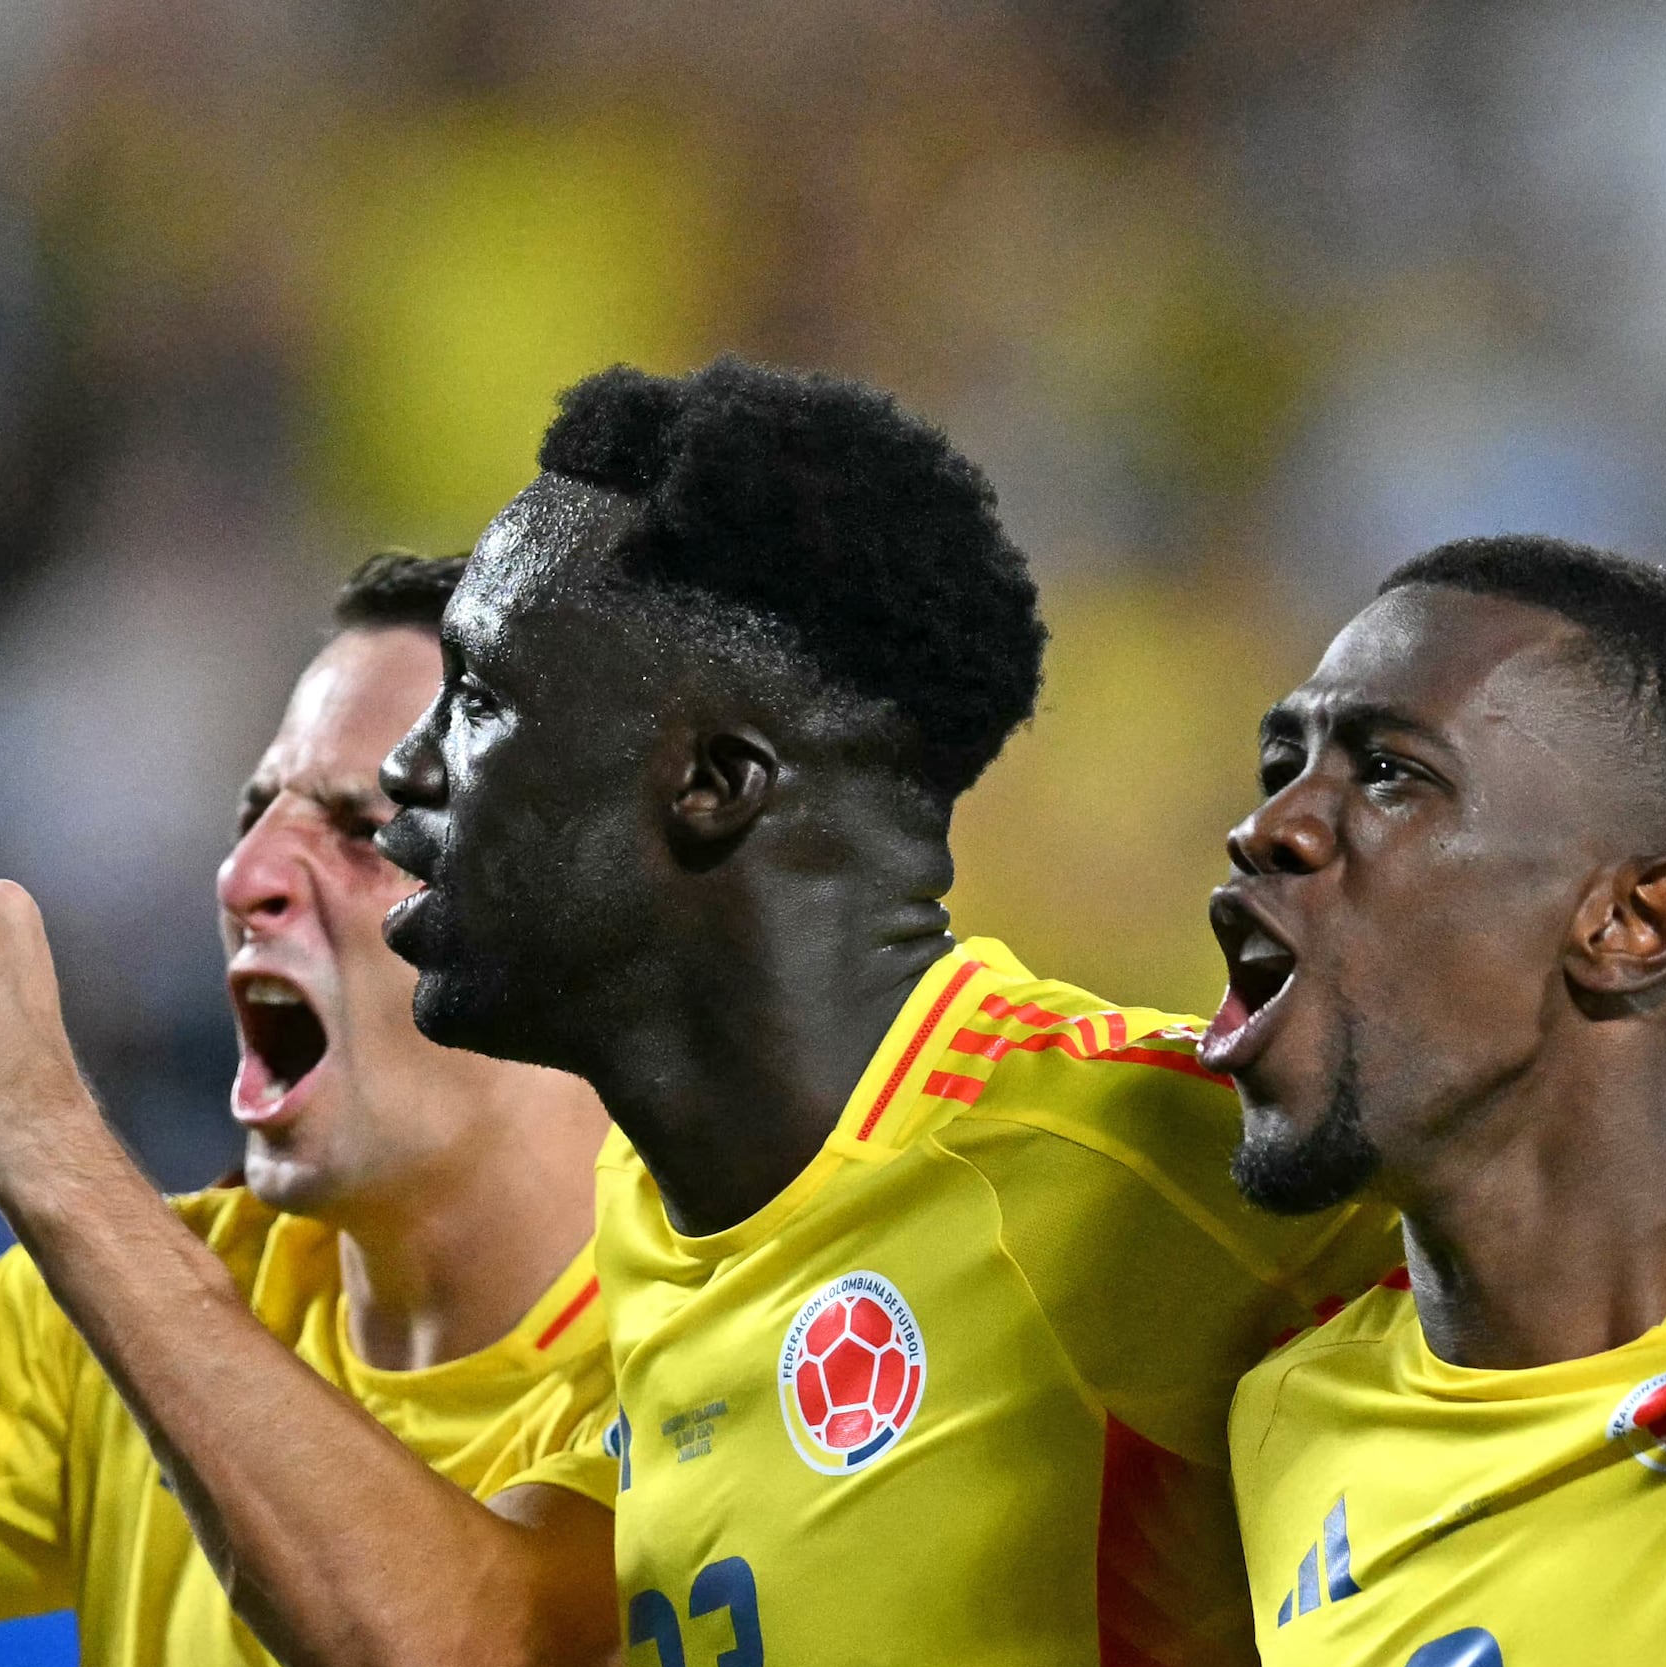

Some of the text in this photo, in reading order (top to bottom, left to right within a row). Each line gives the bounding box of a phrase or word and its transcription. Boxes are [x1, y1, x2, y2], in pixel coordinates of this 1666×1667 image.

[823, 1277, 885, 1302] COLOMBIANA
[883, 1292, 899, 1311] DE
[894, 1306, 920, 1361] FÚTBOL
